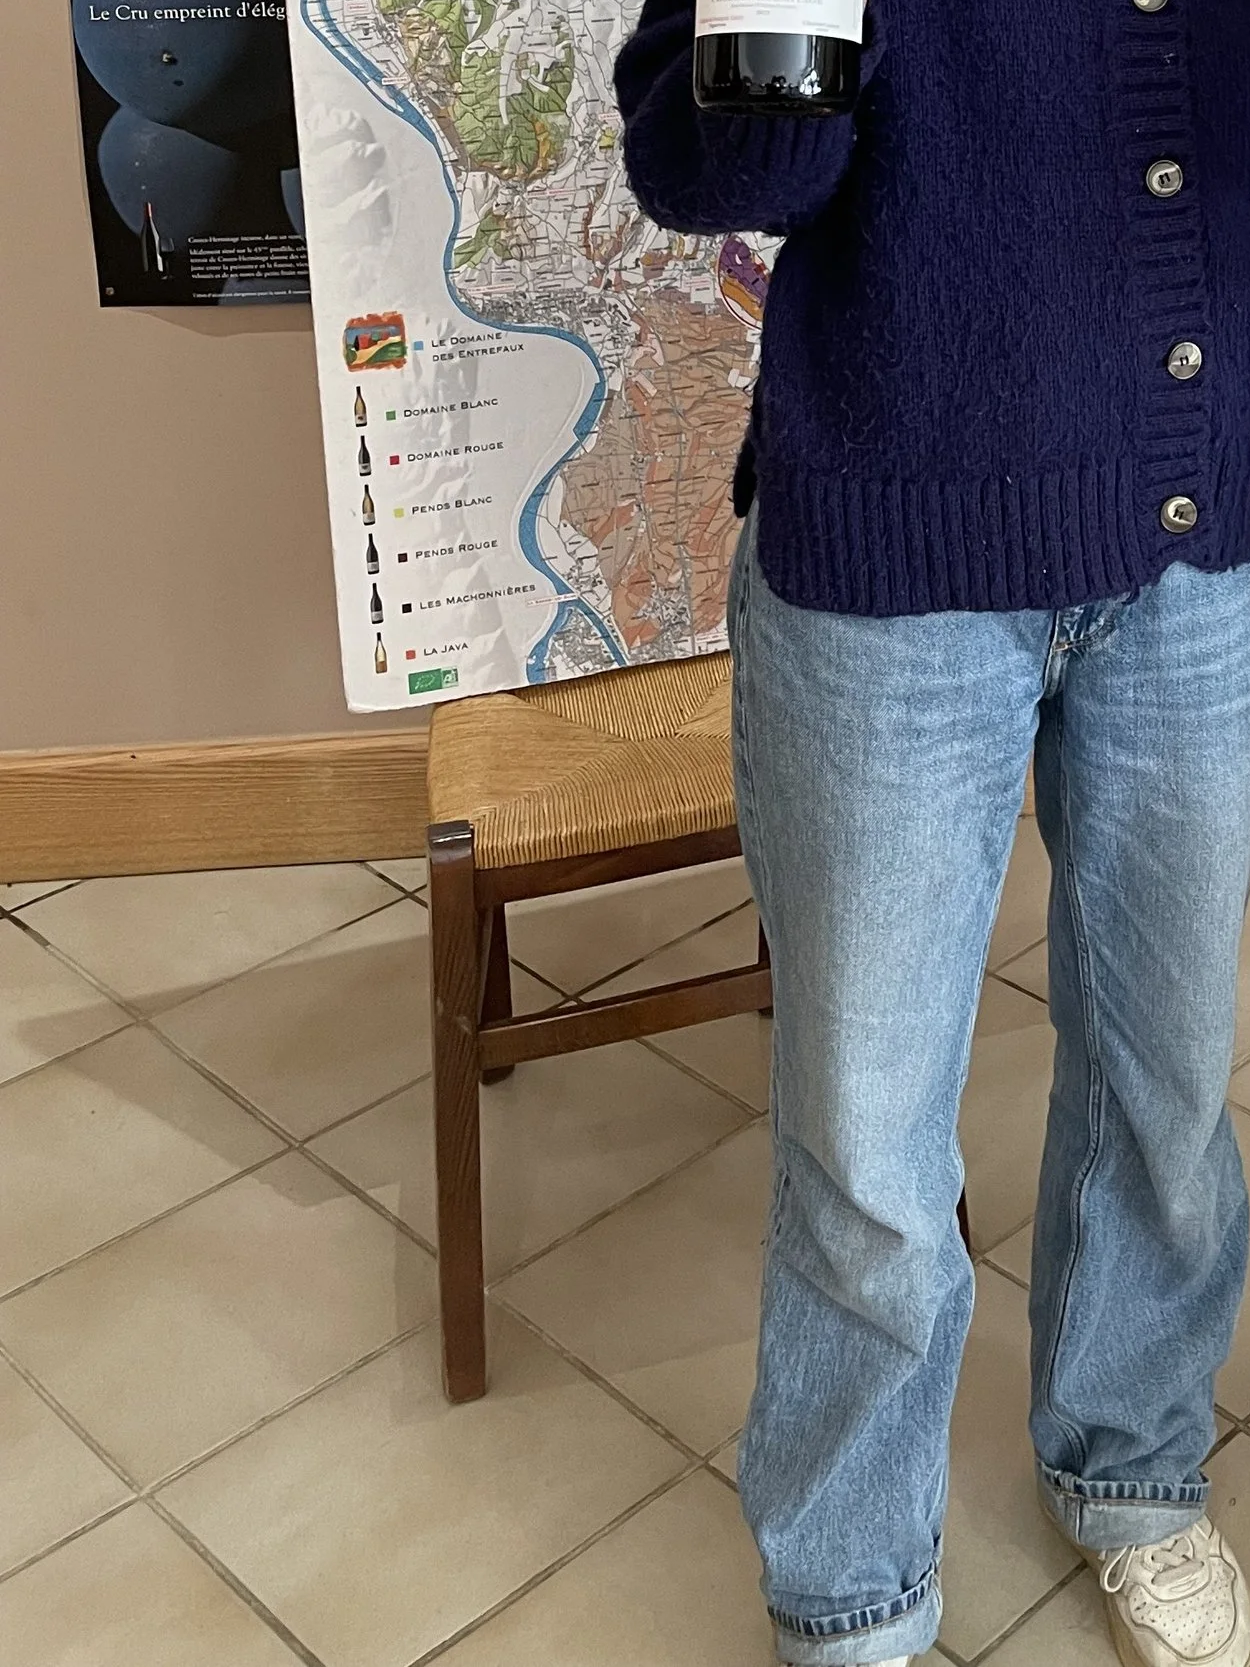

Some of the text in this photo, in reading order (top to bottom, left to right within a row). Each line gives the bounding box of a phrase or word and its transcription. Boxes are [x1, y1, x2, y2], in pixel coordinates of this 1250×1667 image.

[89, 5, 110, 21] Le
[115, 5, 149, 20] Cru
[154, 3, 231, 23] empreint
[431, 332, 503, 348] LE DOMAINE
[432, 343, 525, 362] DES ENTREFAUX
[404, 398, 499, 418] DOMAINE BLANC
[407, 441, 504, 462] DOMAINE ROUGE
[412, 496, 493, 515] PENDS BLANC
[415, 540, 499, 559] PENDS ROUGE
[420, 599, 442, 610] LES
[446, 584, 536, 605] MACHONNIÈRES
[424, 642, 469, 657] LA JAVA
